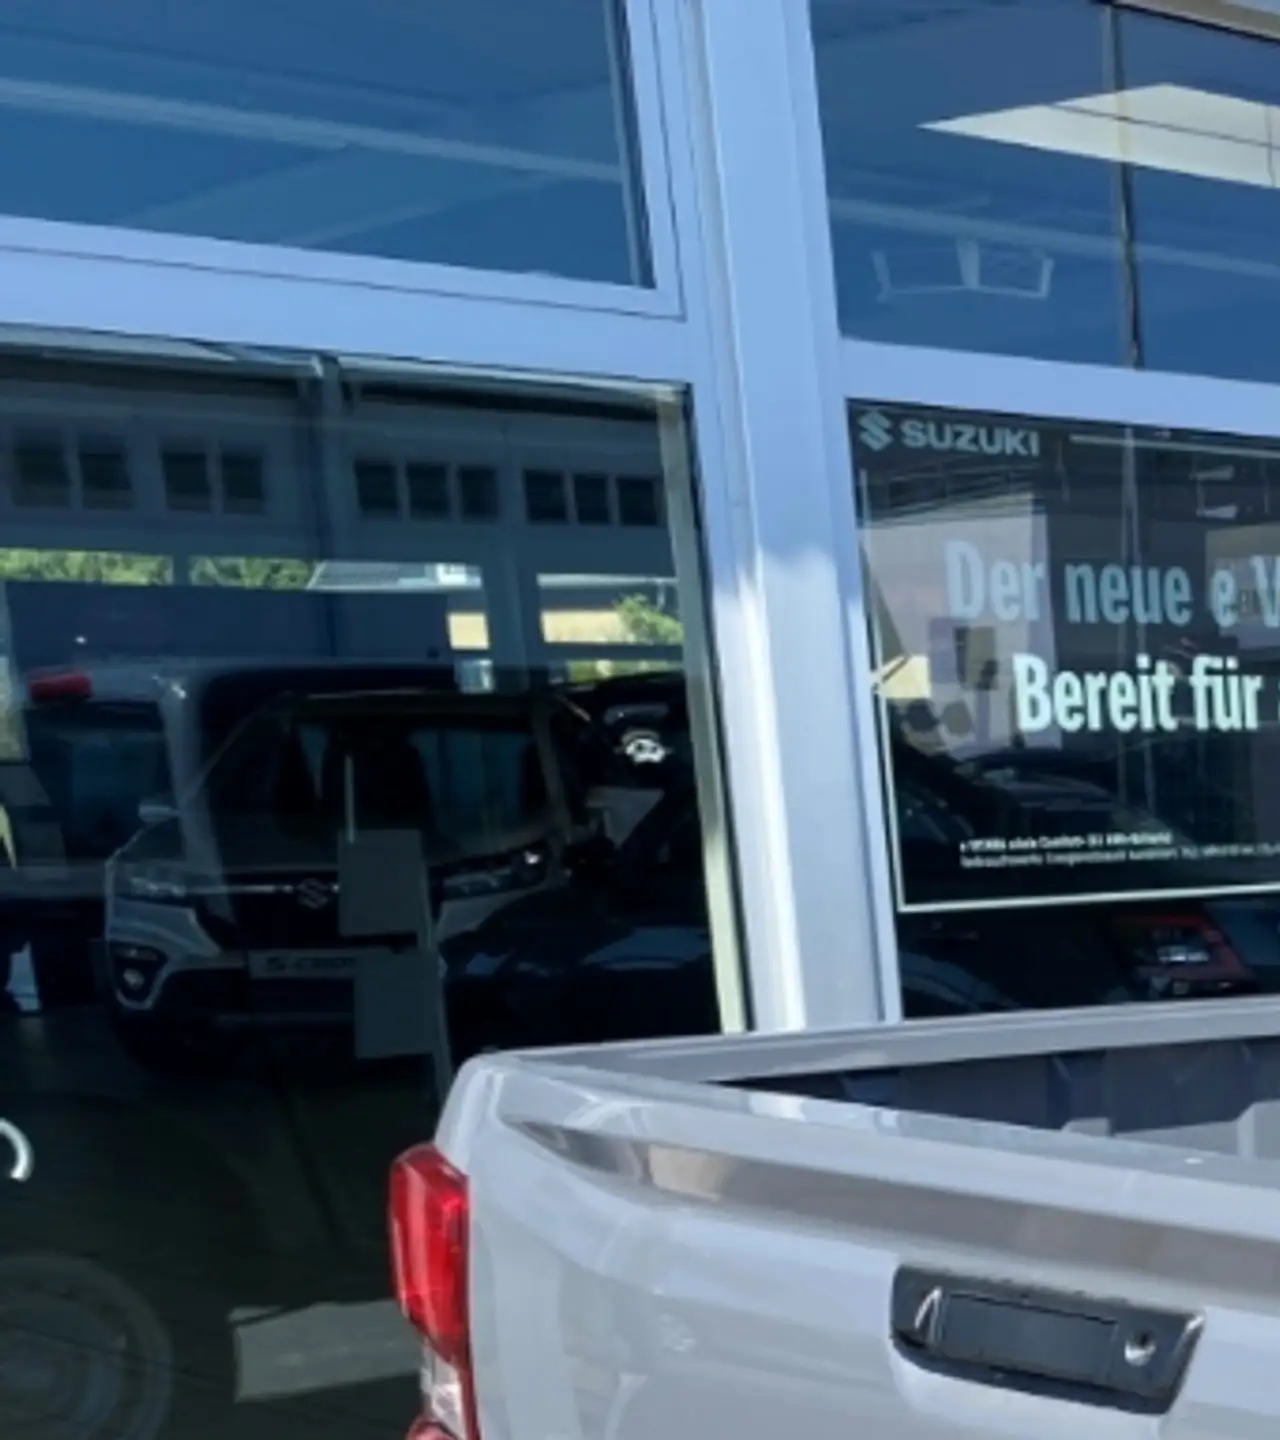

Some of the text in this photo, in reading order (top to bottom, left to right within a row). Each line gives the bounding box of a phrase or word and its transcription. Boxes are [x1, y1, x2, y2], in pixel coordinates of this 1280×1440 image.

[901, 419, 1040, 457] SUZUKI
[943, 540, 1044, 622] Der
[1064, 561, 1193, 626] neue
[1210, 567, 1238, 628] e
[1012, 653, 1178, 733] Bereit
[1188, 655, 1263, 732] für
